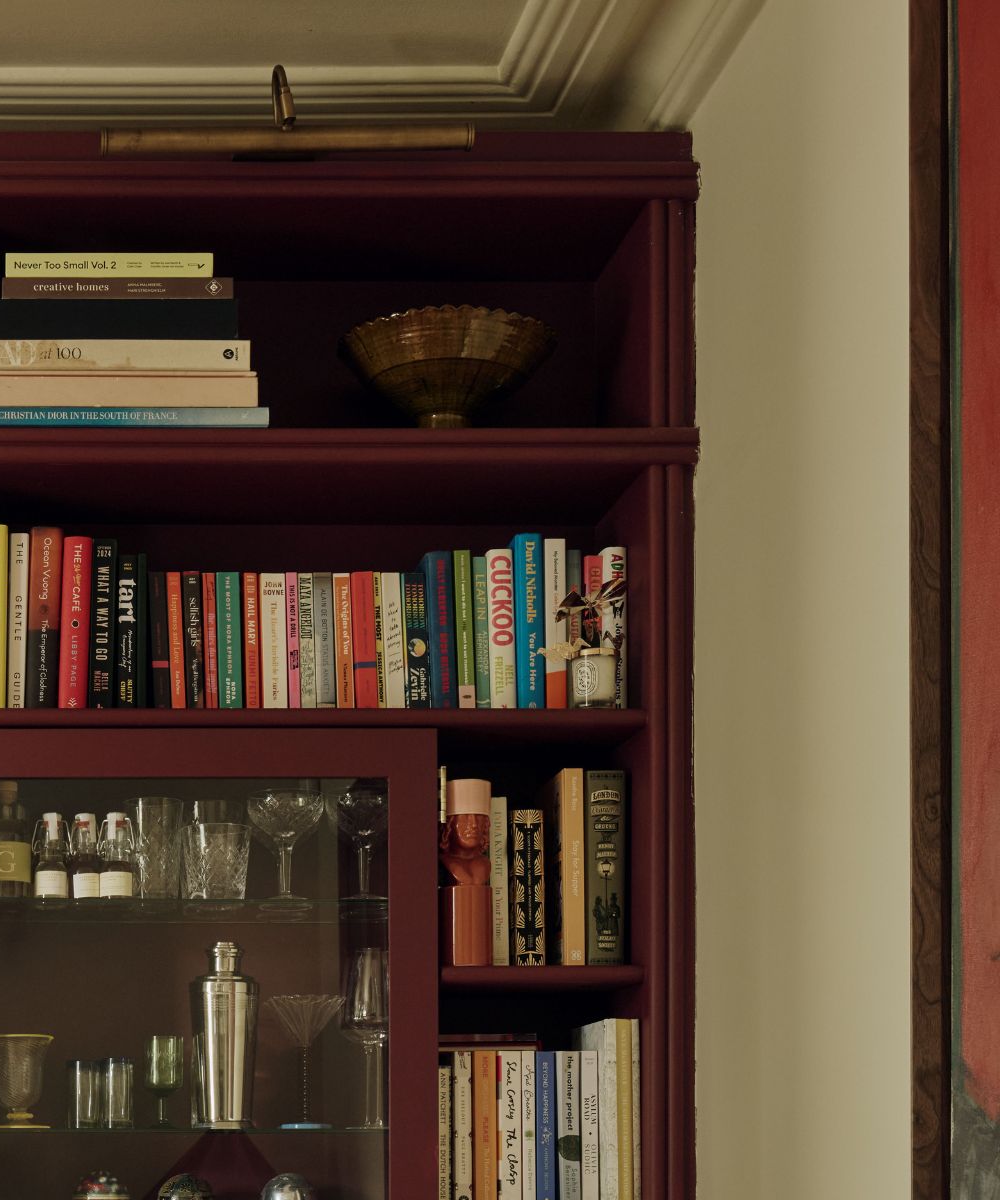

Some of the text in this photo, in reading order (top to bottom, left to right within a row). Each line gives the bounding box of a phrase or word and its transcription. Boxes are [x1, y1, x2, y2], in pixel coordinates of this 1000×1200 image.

[14, 261, 116, 269] Never Too Small Vol. 2
[33, 282, 109, 292] creative homes
[47, 411, 68, 419] DIOR
[70, 411, 78, 419] IN
[79, 411, 98, 419] THE
[100, 411, 128, 419] SOUTH
[130, 411, 141, 419] OF
[143, 411, 178, 420] FRANCE
[38, 537, 52, 600] Ocean Vuong
[97, 566, 110, 592] WHAT
[526, 540, 536, 623] David Nicholls
[118, 578, 136, 624] tart
[300, 577, 312, 600] MAYA
[476, 574, 486, 620] LEAP IN
[490, 556, 514, 646] CUCKOO
[12, 543, 24, 708] THE GENTLE GUIDE
[96, 608, 108, 628] WAY
[188, 597, 200, 647] selfish girls
[300, 602, 312, 640] ANGELOU
[340, 600, 349, 629] Origins
[96, 632, 108, 644] TO
[248, 620, 256, 645] MARY
[343, 630, 350, 639] of
[96, 648, 108, 661] GO
[410, 668, 420, 701] Zevin
[494, 656, 506, 696] FRIZZELL
[506, 664, 514, 686] NELL
[566, 1102, 574, 1130] project
[506, 1128, 518, 1186] The Clasp
